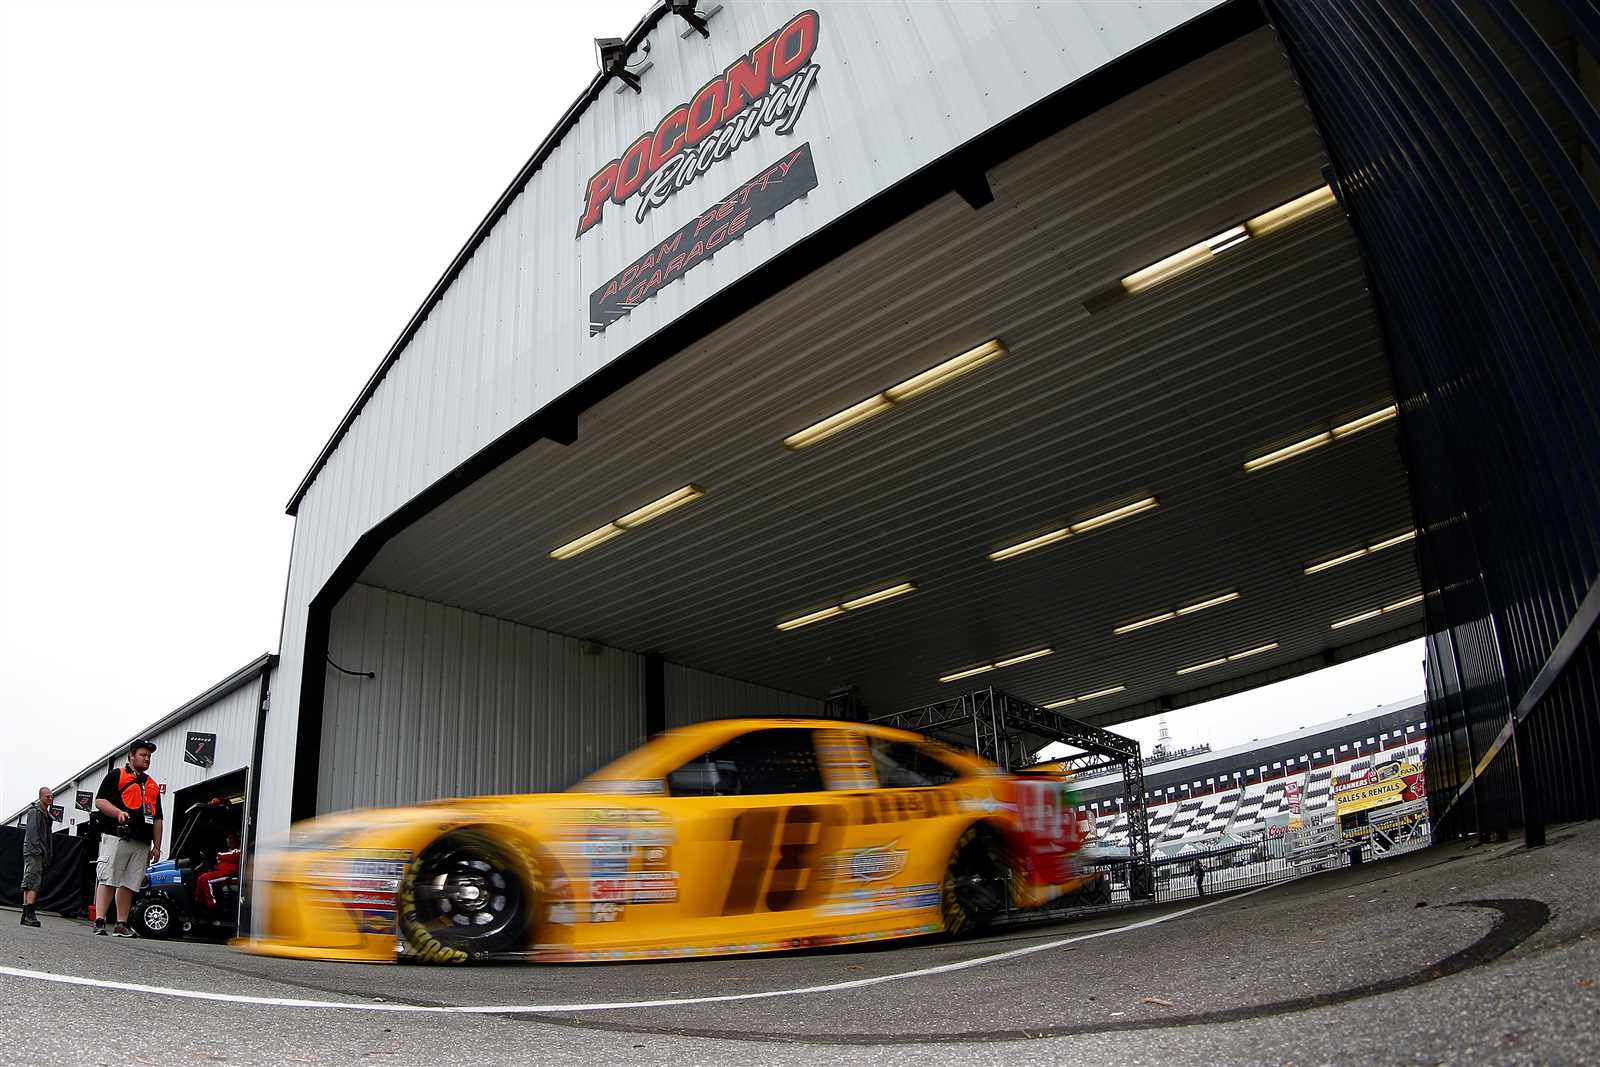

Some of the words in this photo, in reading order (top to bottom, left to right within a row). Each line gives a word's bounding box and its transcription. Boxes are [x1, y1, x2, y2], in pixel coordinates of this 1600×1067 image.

[576, 9, 819, 239] POCONO
[635, 63, 820, 224] Raceway
[599, 232, 682, 304] ADAM
[694, 151, 802, 237] PETTY
[625, 206, 751, 304] GARAGE
[1334, 779, 1368, 792] SCANNERS
[1338, 792, 1360, 805] SALES
[1361, 791, 1367, 799] &
[1368, 782, 1400, 797] RENTALS
[720, 803, 848, 917] 18
